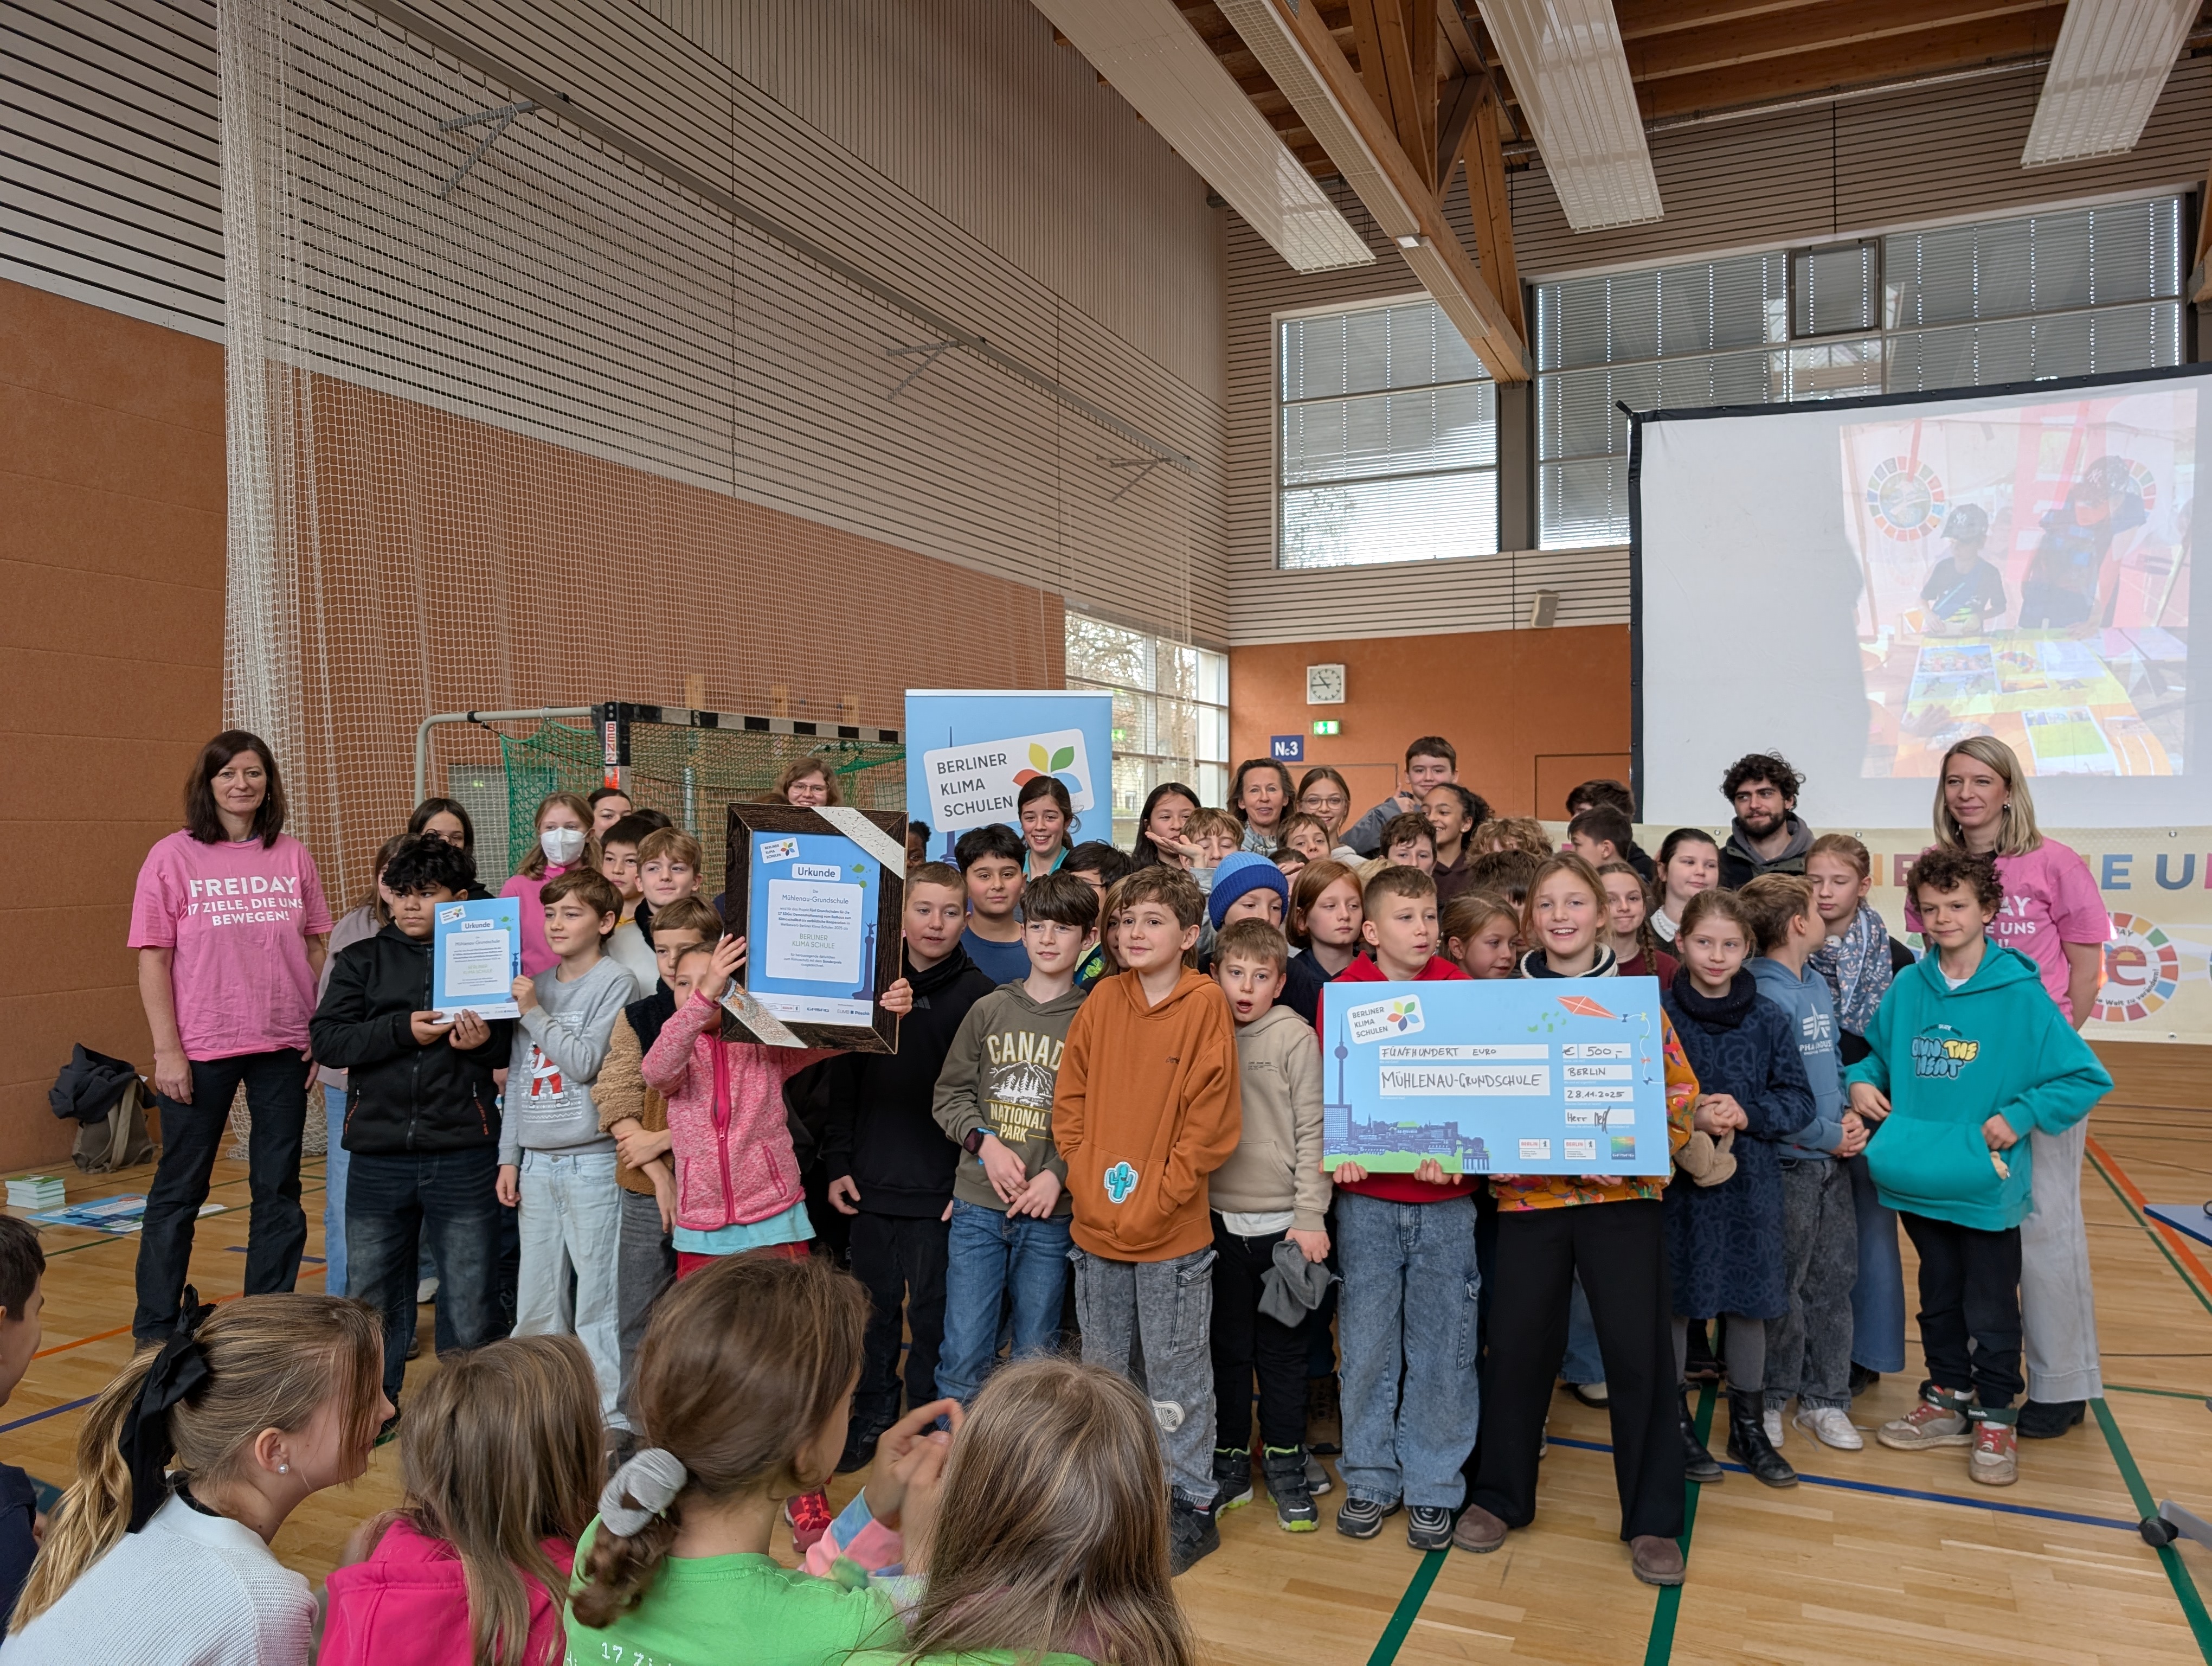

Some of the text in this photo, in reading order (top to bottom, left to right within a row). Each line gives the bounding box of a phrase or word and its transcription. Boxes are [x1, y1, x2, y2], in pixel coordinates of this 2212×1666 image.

[937, 753, 1007, 774] BERLINER
[941, 778, 986, 796] KLIMA
[944, 796, 1013, 817] SCHULEN
[798, 867, 835, 877] Urkunde
[190, 876, 297, 898] FREIDAY
[782, 894, 849, 904] Mühlenau-Grundschule
[188, 897, 303, 916] 17 ZIELE, DIE UNS
[212, 911, 290, 926] BEWEGEN!
[2001, 921, 2035, 934] UNS
[1352, 1007, 1384, 1018] BERLINER
[1354, 1018, 1375, 1028] KLIMA
[1356, 1026, 1388, 1037] SCHULEN
[987, 1031, 1065, 1071] CANAD
[1381, 1046, 1459, 1058] FÜNFHUNDERT
[1567, 1067, 1605, 1077] BERLIN
[1567, 1090, 1625, 1099] 28.11.2025
[990, 1102, 1046, 1130] NATIONAL
[1567, 1112, 1587, 1122] Herr
[999, 1124, 1028, 1142] PARK
[601, 1642, 623, 1663] 17
